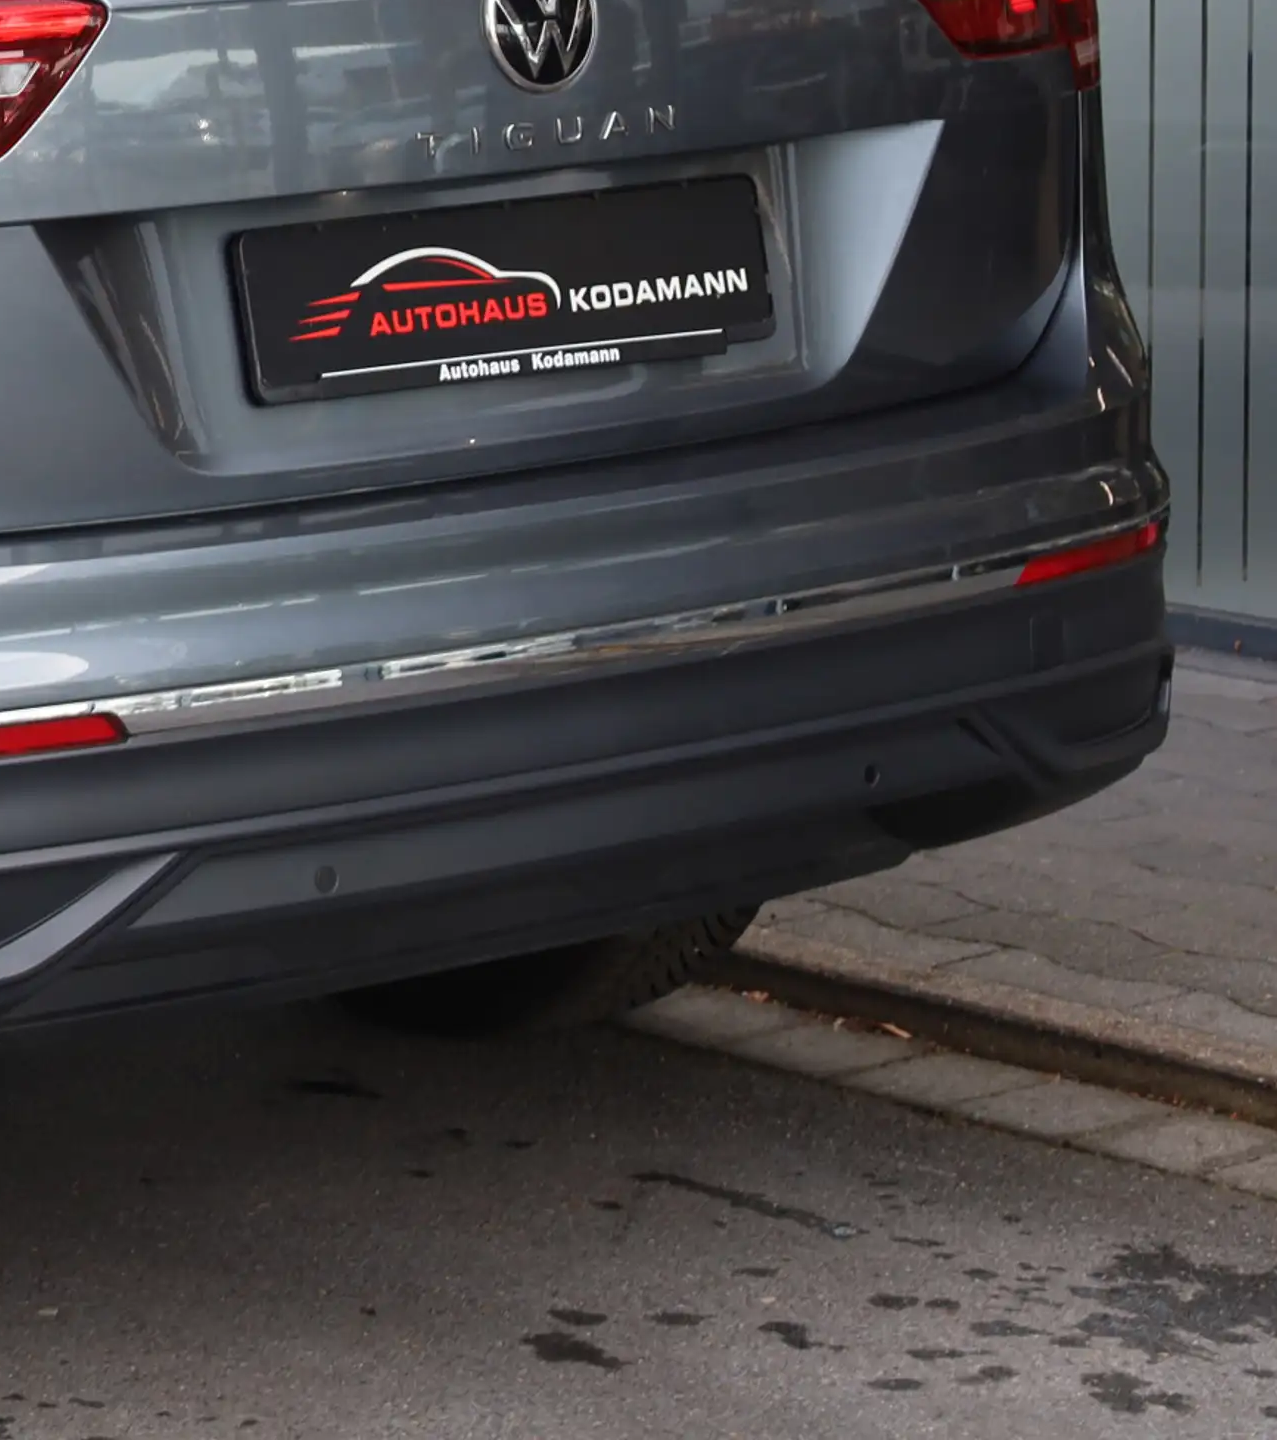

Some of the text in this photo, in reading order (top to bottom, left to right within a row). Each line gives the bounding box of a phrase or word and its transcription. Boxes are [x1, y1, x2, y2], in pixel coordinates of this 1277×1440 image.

[415, 104, 677, 159] TIGUAN
[369, 266, 749, 338] AUTOHAUS KODAMANN
[438, 345, 621, 382] Autohaus Kodamann
